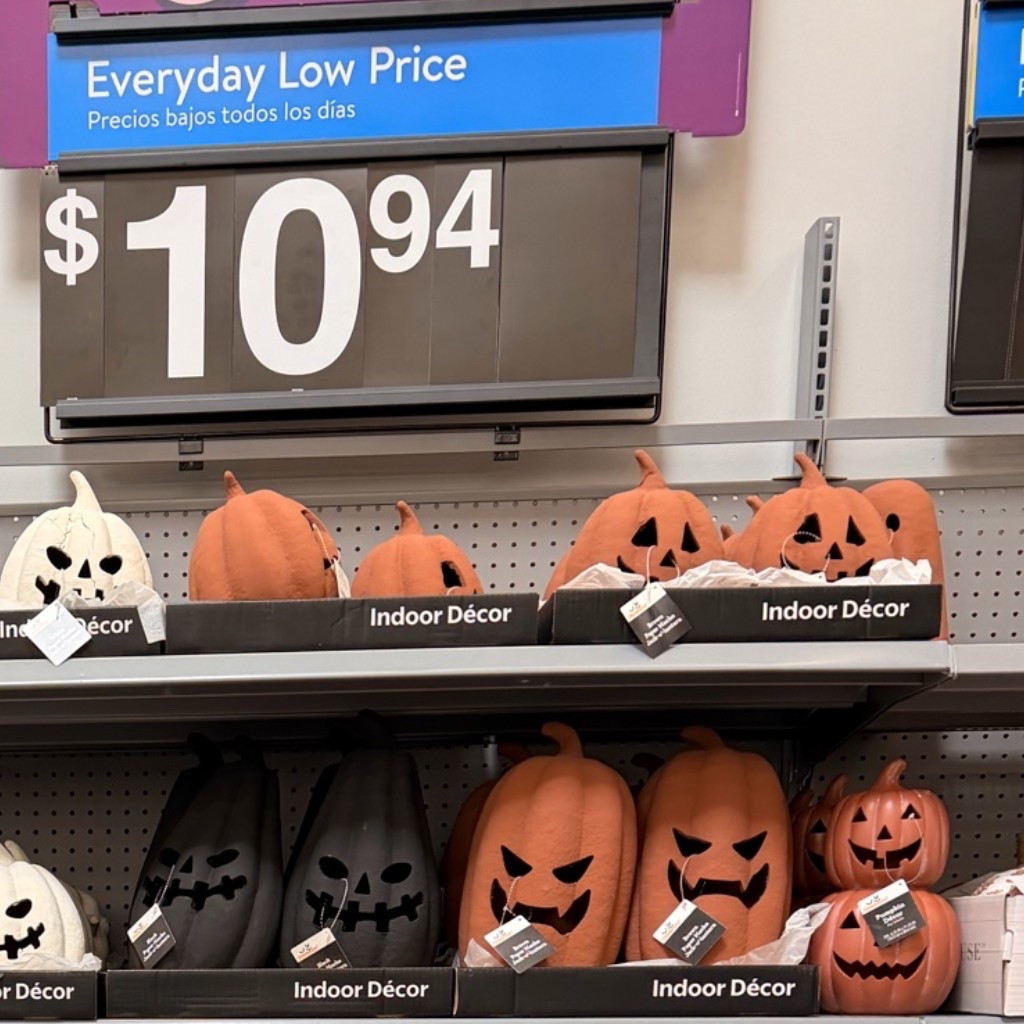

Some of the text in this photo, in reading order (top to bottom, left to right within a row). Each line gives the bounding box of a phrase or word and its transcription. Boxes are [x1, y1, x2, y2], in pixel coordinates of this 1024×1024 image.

[87, 44, 467, 106] Everyday Low Price
[88, 100, 356, 131] Precios bajos todos los días
[371, 604, 512, 626] Indoor Décor
[763, 599, 909, 620] Indoor Décor
[15, 981, 75, 1000] Décor
[295, 980, 428, 998] Indoor Décor
[653, 978, 795, 997] Indoor Décor
